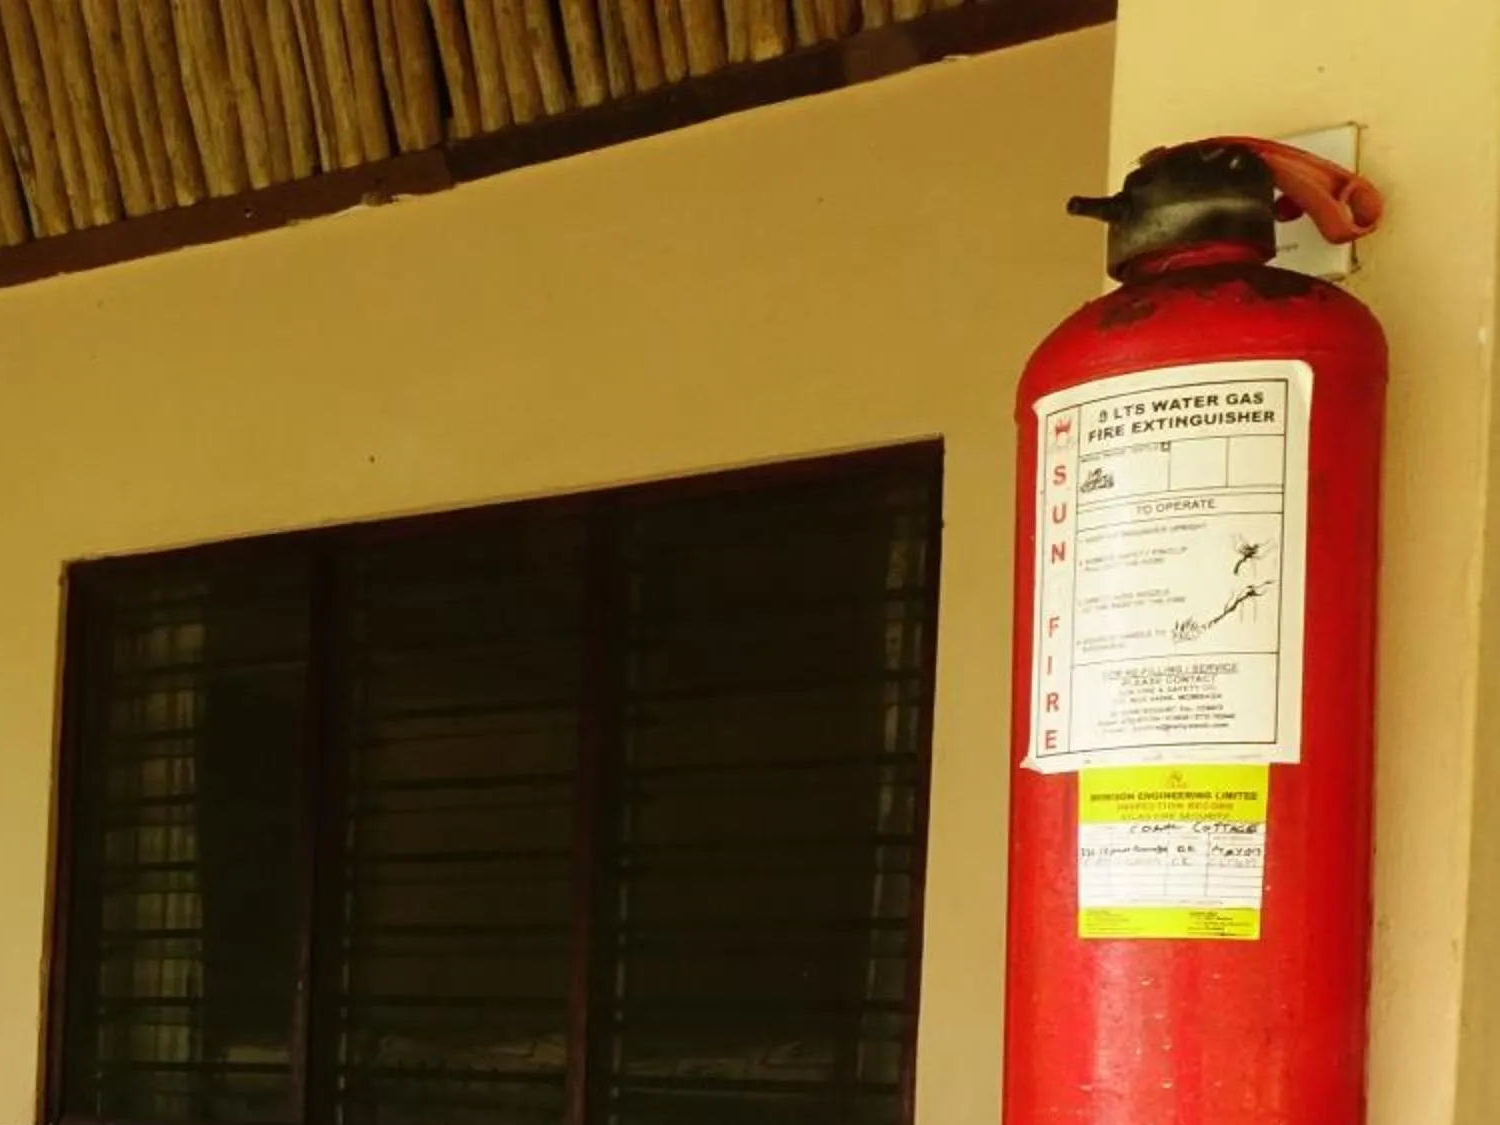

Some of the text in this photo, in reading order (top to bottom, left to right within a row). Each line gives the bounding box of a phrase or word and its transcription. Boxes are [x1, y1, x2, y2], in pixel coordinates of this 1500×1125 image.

[1113, 403, 1146, 420] LTS
[1151, 395, 1219, 413] WATER
[1225, 391, 1265, 405] GAS
[1088, 410, 1276, 444] FIRE EXTINGUISHER
[1136, 499, 1216, 515] TO OPERATE
